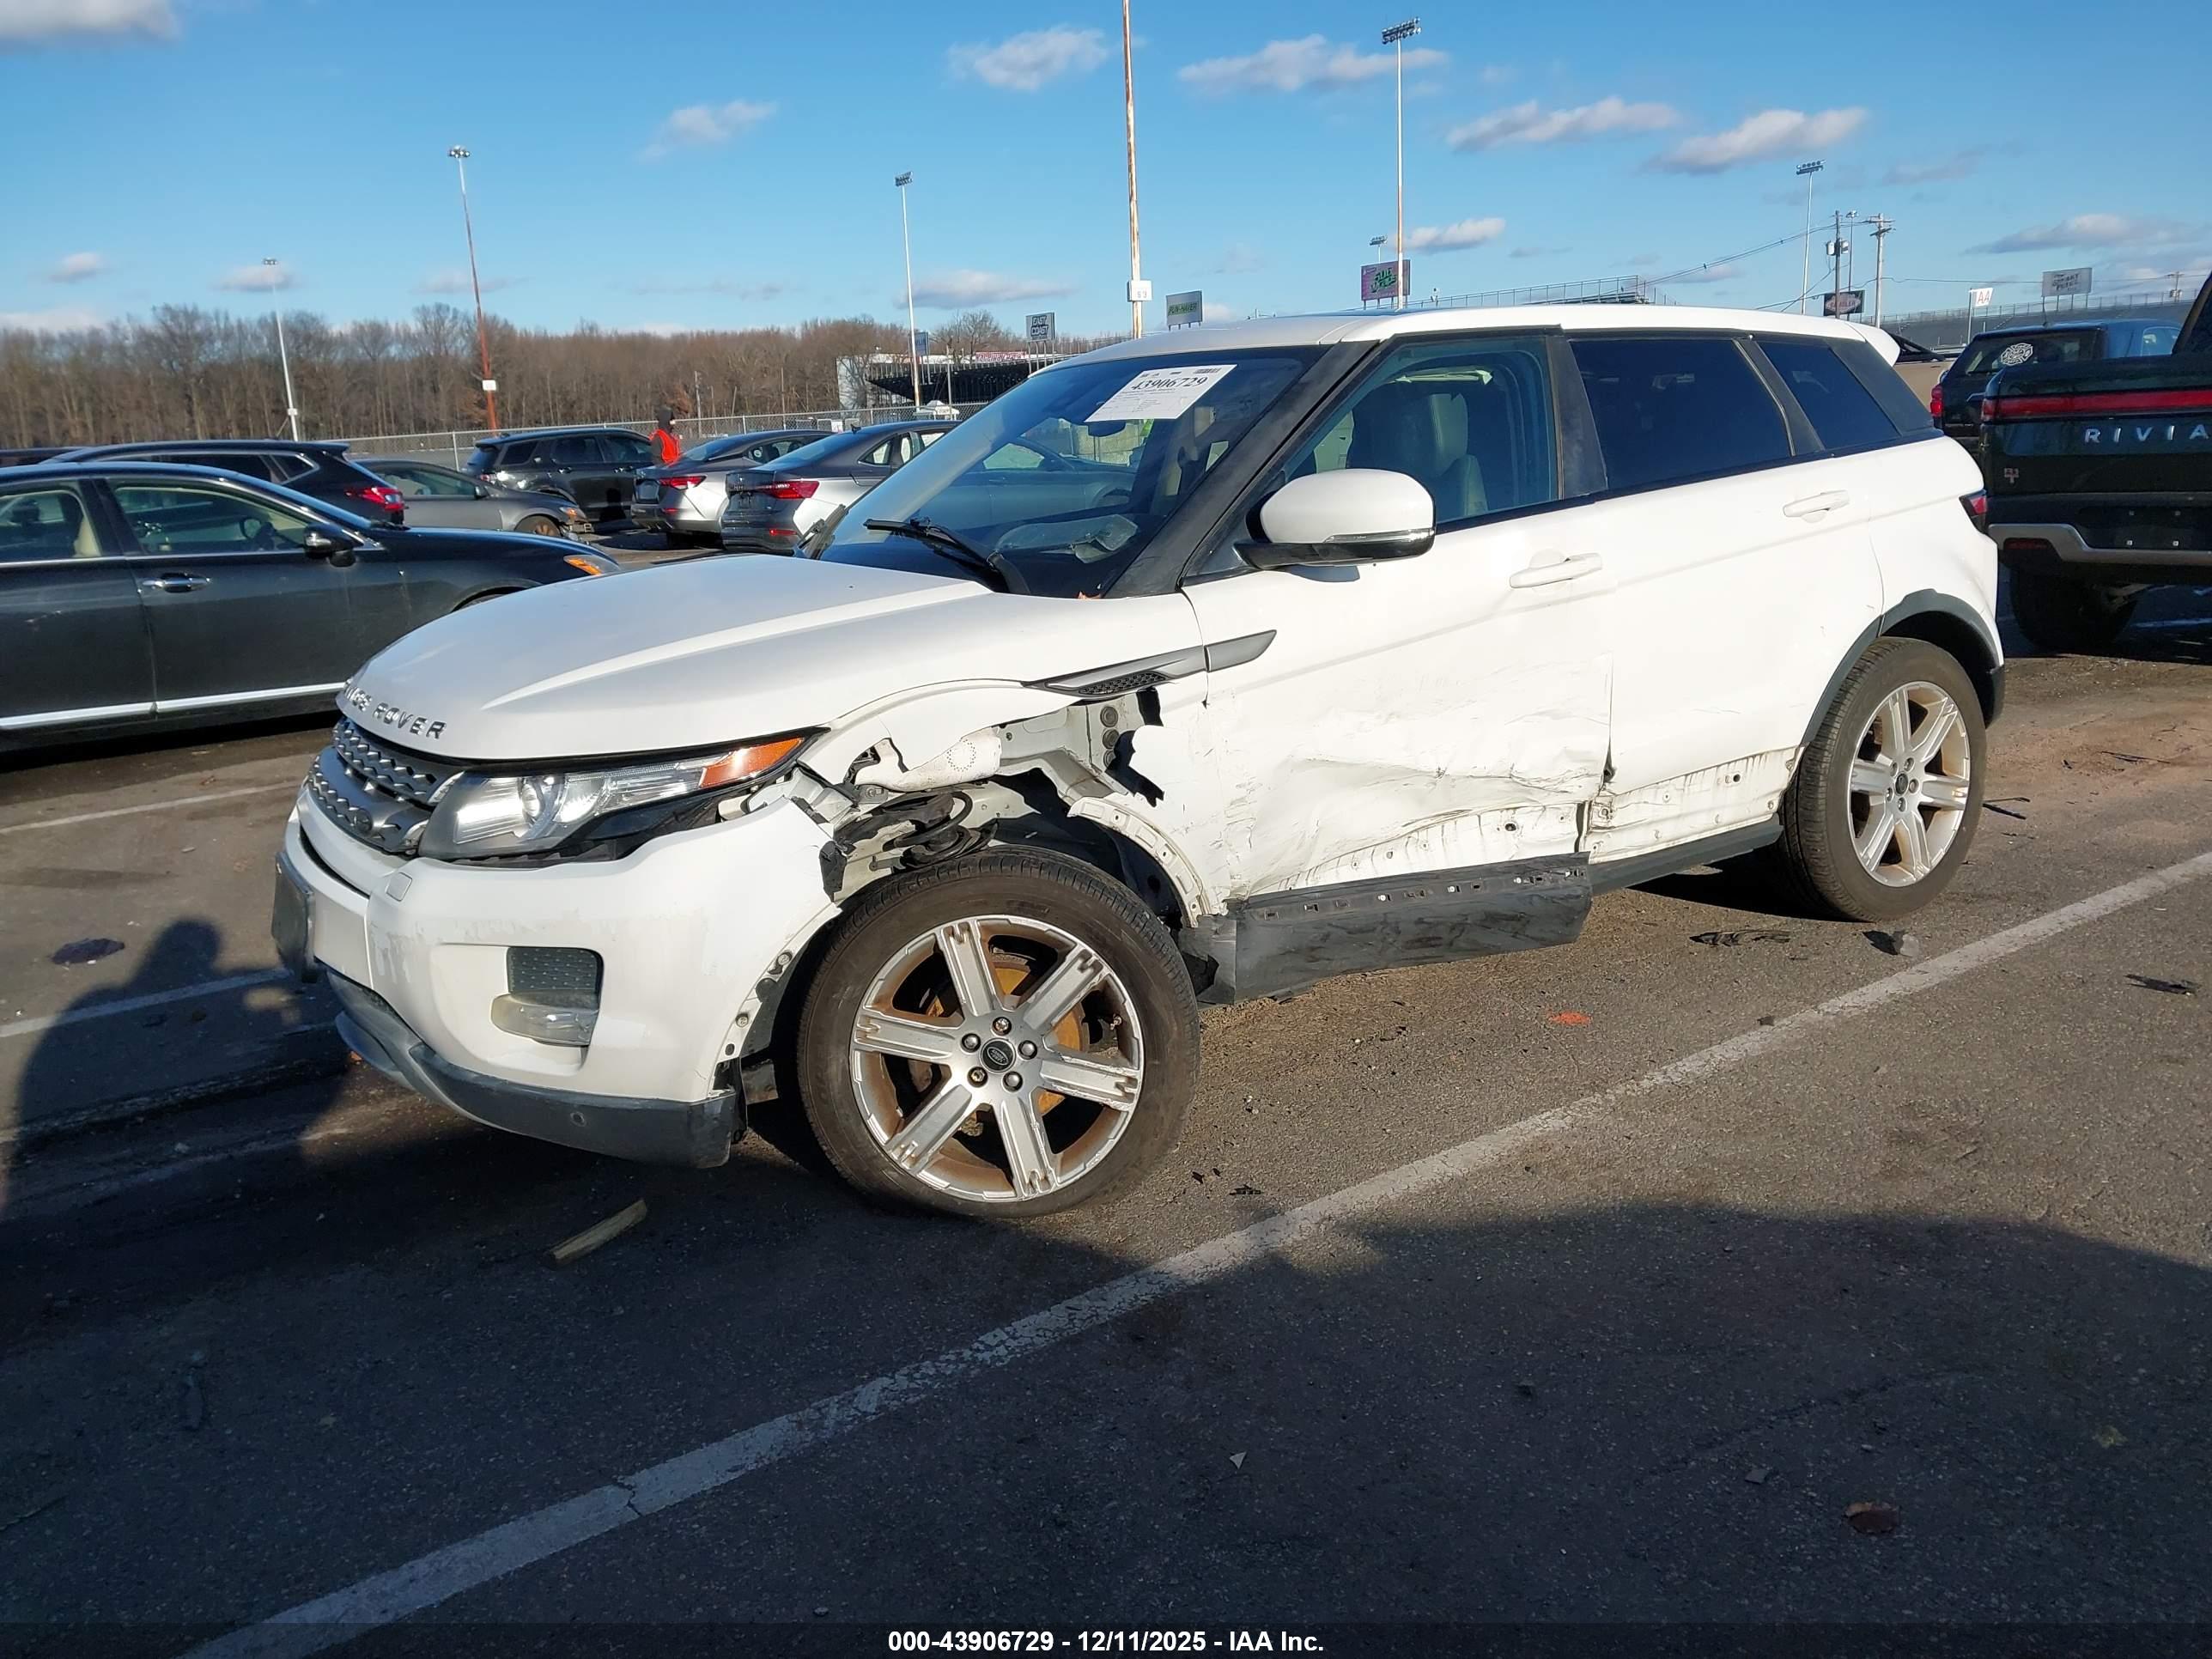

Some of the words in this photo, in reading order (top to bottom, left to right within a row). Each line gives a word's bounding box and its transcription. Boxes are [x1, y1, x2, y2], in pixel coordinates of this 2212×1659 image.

[1032, 315, 1047, 325] EAST
[1030, 325, 1048, 337] COAST
[1131, 376, 1208, 391] 43906729
[373, 702, 447, 739] ROVER
